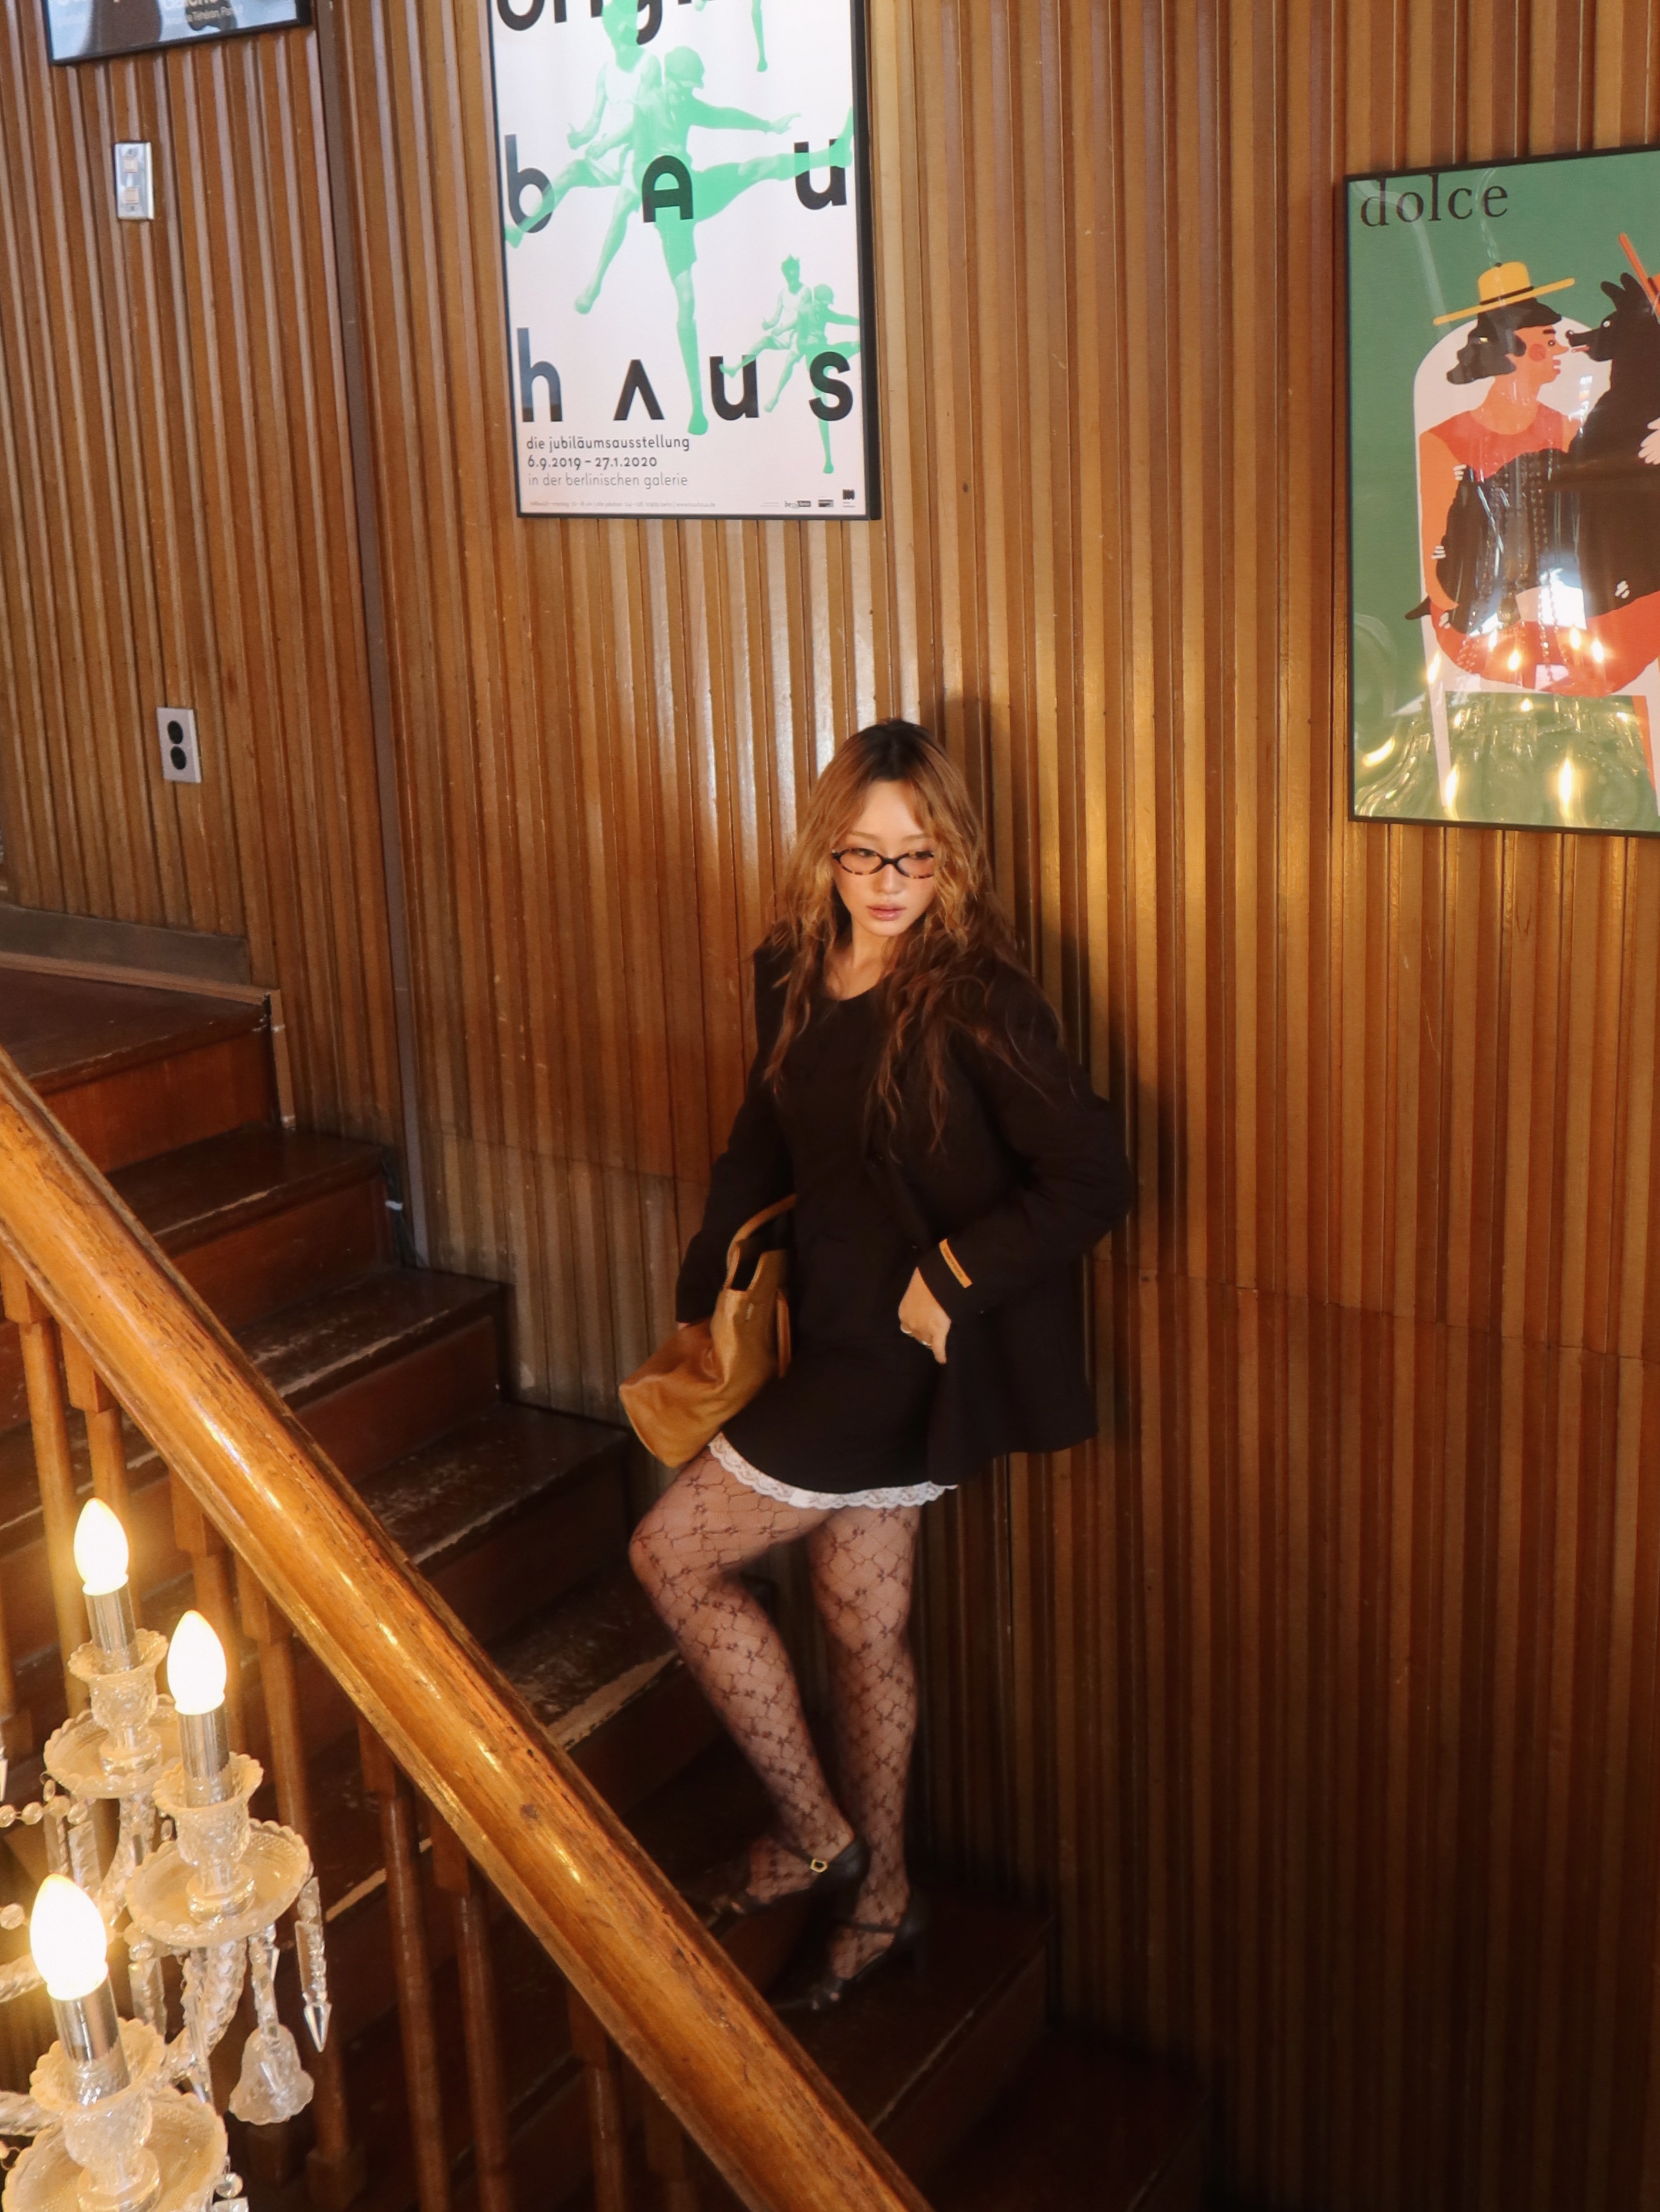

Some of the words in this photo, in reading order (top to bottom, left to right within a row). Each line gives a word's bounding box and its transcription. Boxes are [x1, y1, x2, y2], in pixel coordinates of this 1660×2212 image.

[1360, 174, 1508, 227] dolce
[526, 436, 546, 449] die
[549, 435, 690, 453] jubiläumsausstellung
[527, 454, 582, 471] 6.9.2019
[594, 456, 657, 471] 27.1.2020
[528, 473, 539, 485] in
[542, 473, 562, 486] der
[565, 472, 639, 486] berlinischen
[644, 472, 688, 490] galerie
